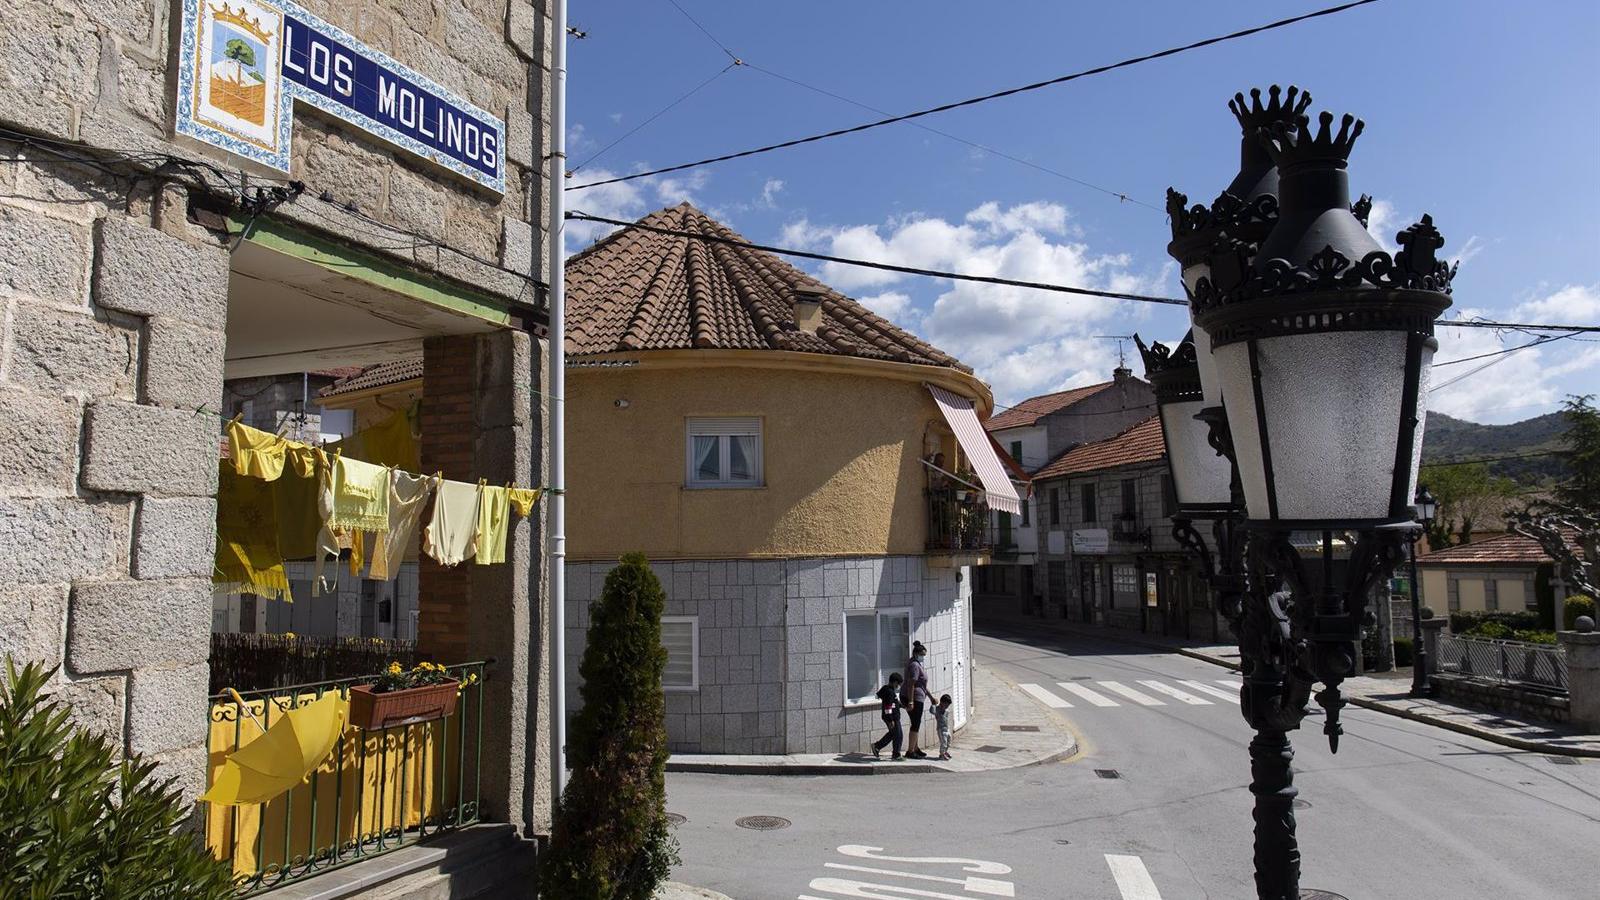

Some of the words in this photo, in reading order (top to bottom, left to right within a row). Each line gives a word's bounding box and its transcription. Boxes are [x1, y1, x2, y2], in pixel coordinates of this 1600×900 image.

[284, 26, 354, 97] LOS
[378, 75, 497, 170] MOLINOS
[798, 844, 1016, 900] STO
